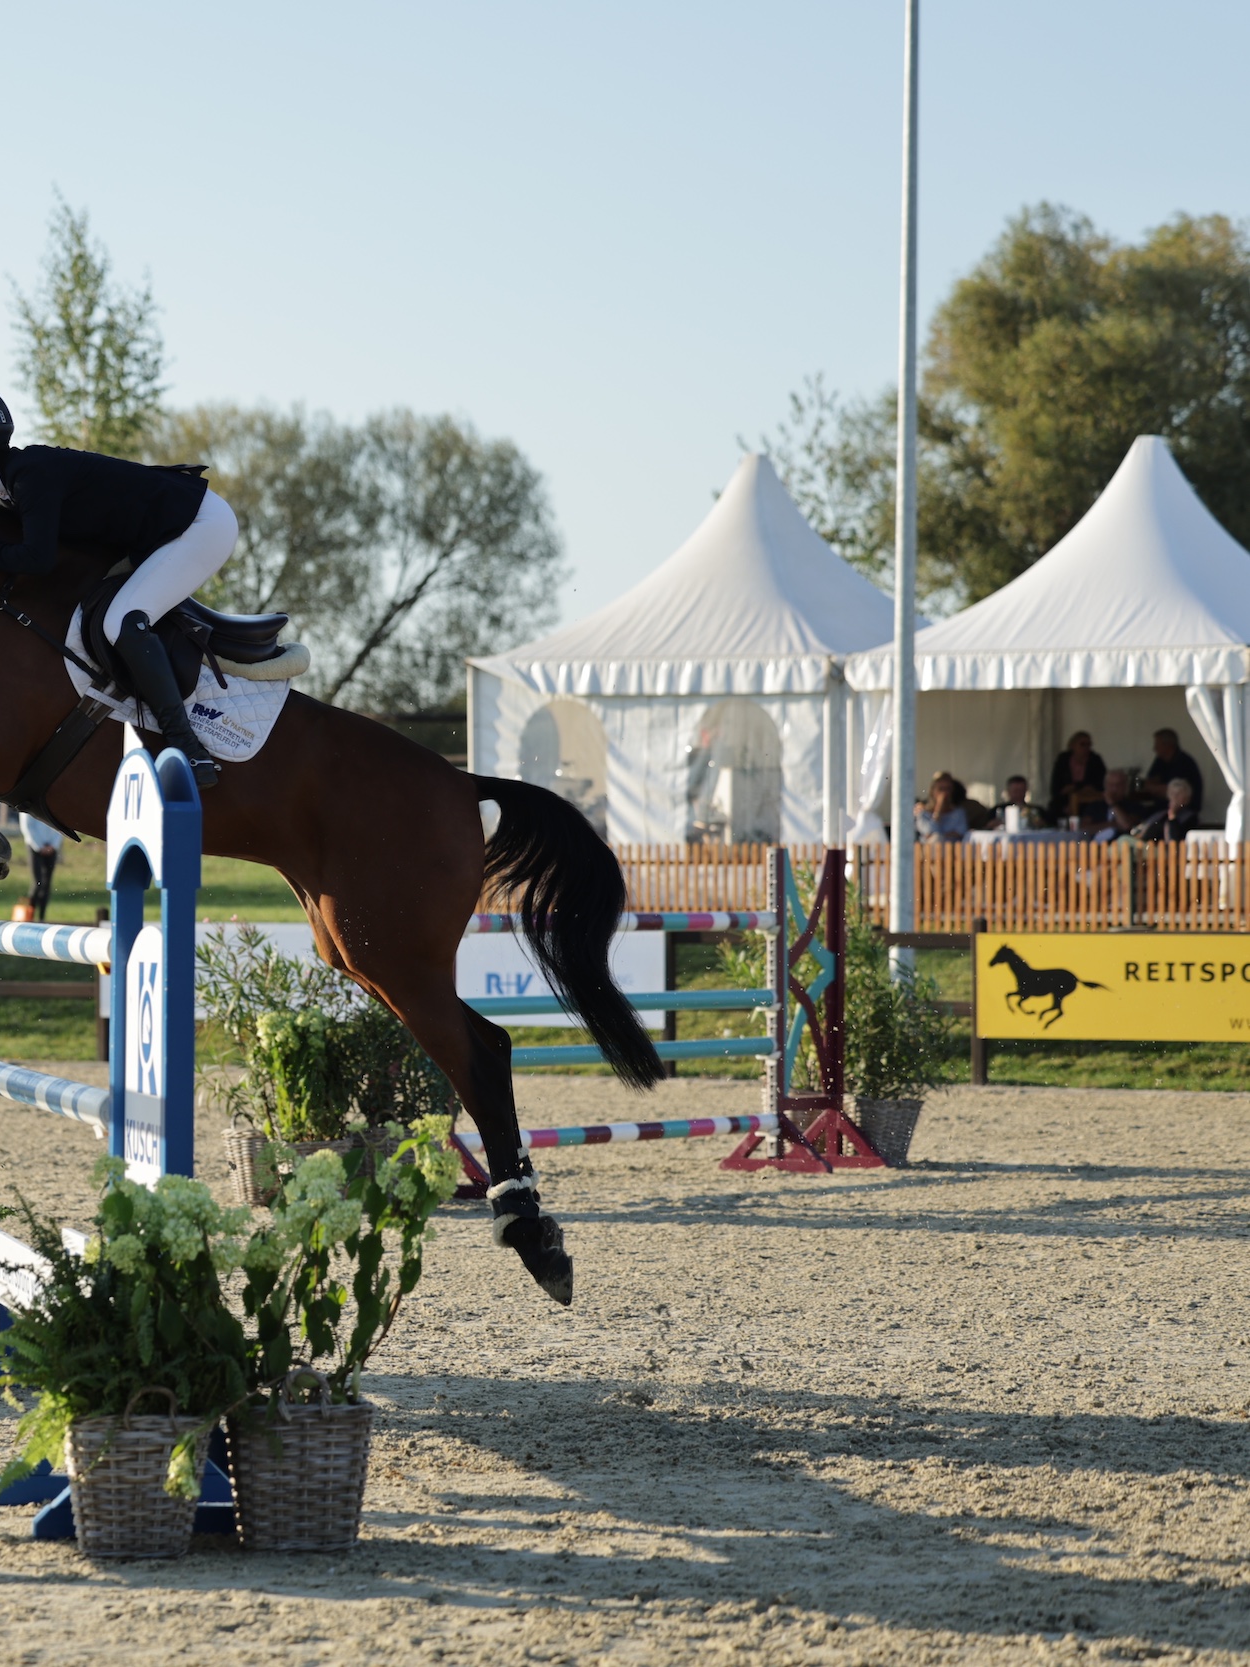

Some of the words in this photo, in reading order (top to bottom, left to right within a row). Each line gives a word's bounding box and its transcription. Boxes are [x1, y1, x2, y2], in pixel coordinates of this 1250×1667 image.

[191, 703, 225, 720] R+V
[189, 714, 252, 749] GENERALVERTRETUNG
[203, 726, 240, 749] STAPELFELDT
[230, 722, 255, 741] PARTNER
[486, 972, 533, 995] R+V
